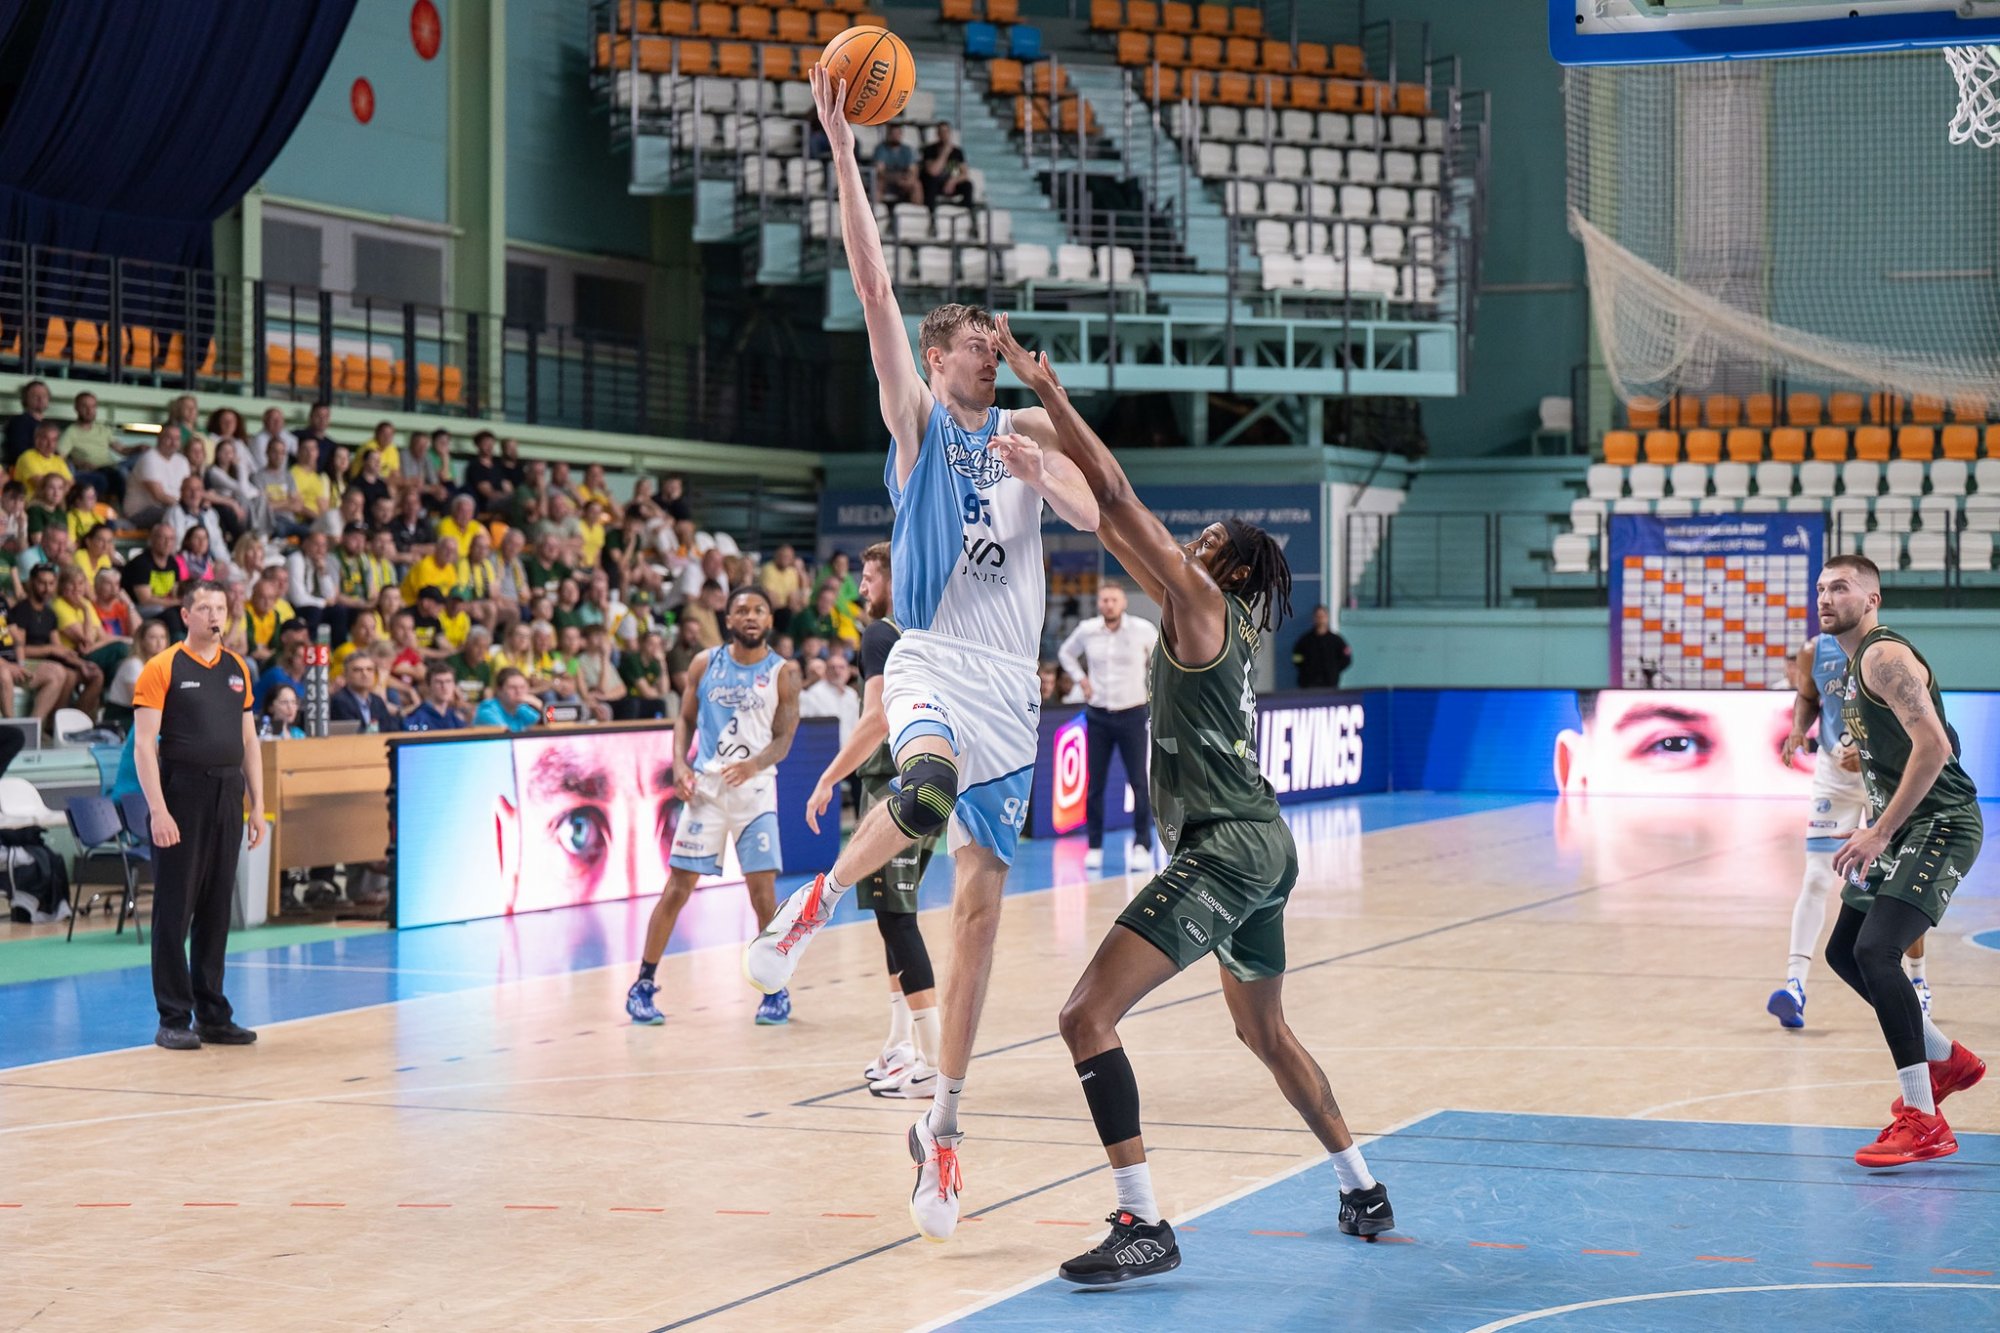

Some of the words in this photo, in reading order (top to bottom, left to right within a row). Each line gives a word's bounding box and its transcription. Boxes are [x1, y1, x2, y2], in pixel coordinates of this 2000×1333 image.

[849, 59, 890, 116] Wilson
[1268, 508, 1312, 523] NITRA
[306, 646, 316, 664] 5
[321, 646, 328, 664] 5
[306, 666, 316, 681] 4
[321, 666, 328, 681] 4
[307, 684, 316, 700] 3
[321, 684, 328, 700] 3
[307, 702, 316, 719] 2
[321, 702, 329, 719] 2
[310, 721, 315, 736] 1
[728, 717, 738, 735] 3
[1255, 705, 1364, 793] UEWINGS
[1000, 797, 1029, 829] 95
[756, 832, 770, 852] 3
[1143, 858, 1198, 917] EVICE
[1115, 1237, 1166, 1266] AIR
